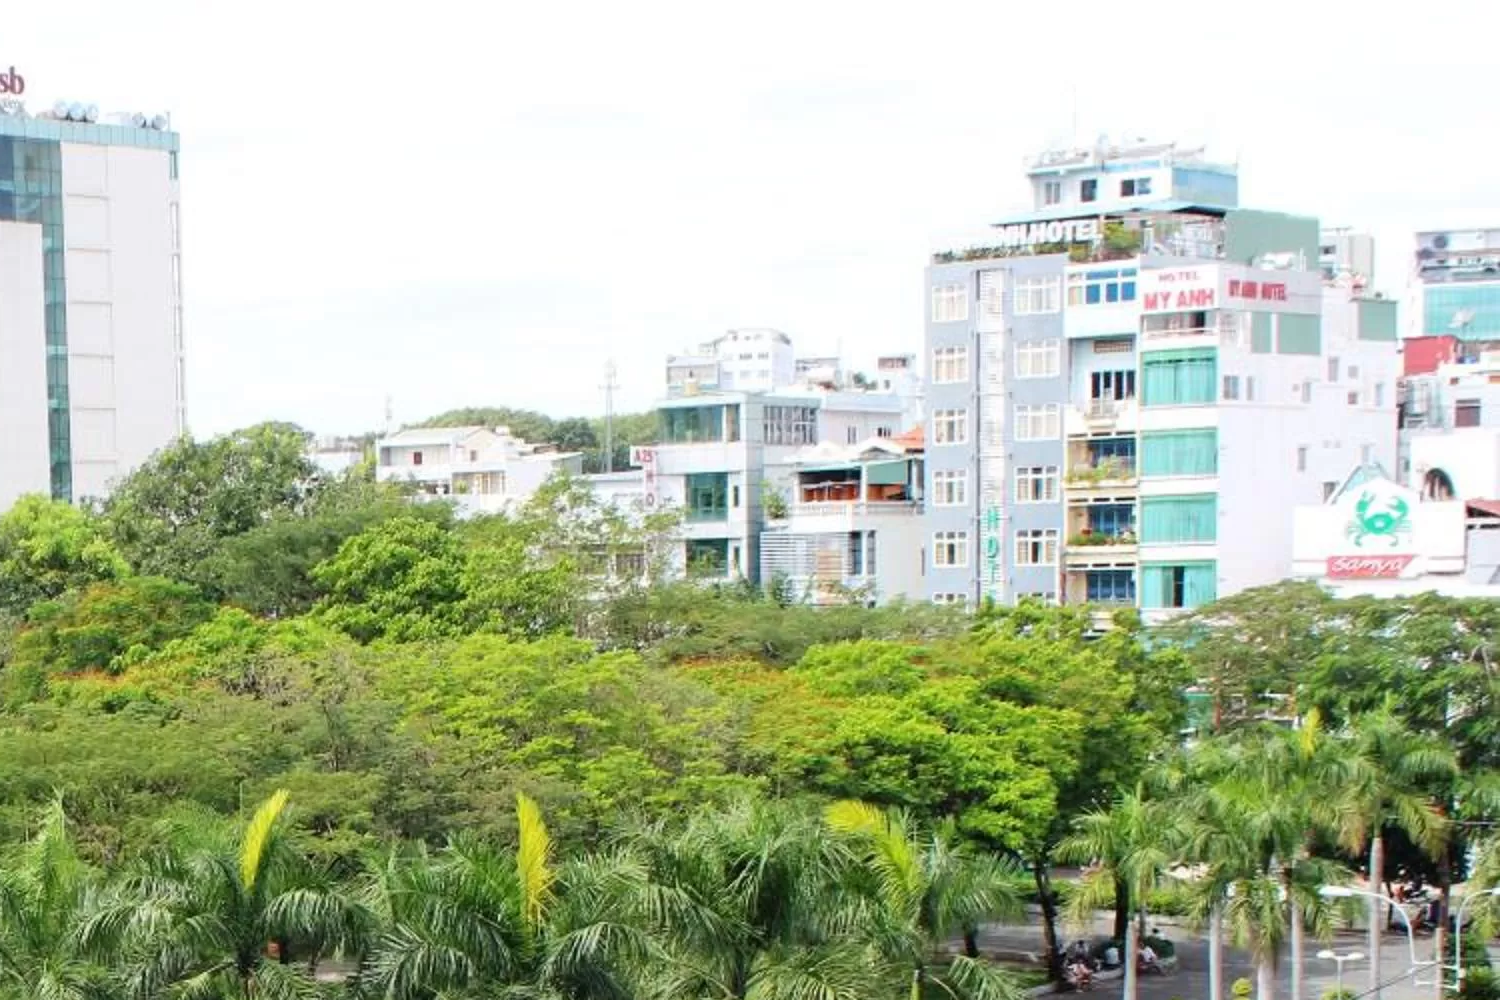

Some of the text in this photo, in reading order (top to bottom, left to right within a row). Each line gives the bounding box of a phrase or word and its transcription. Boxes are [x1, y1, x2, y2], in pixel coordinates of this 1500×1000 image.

[1159, 271, 1199, 283] HOTEL
[1143, 287, 1215, 311] MY ANH
